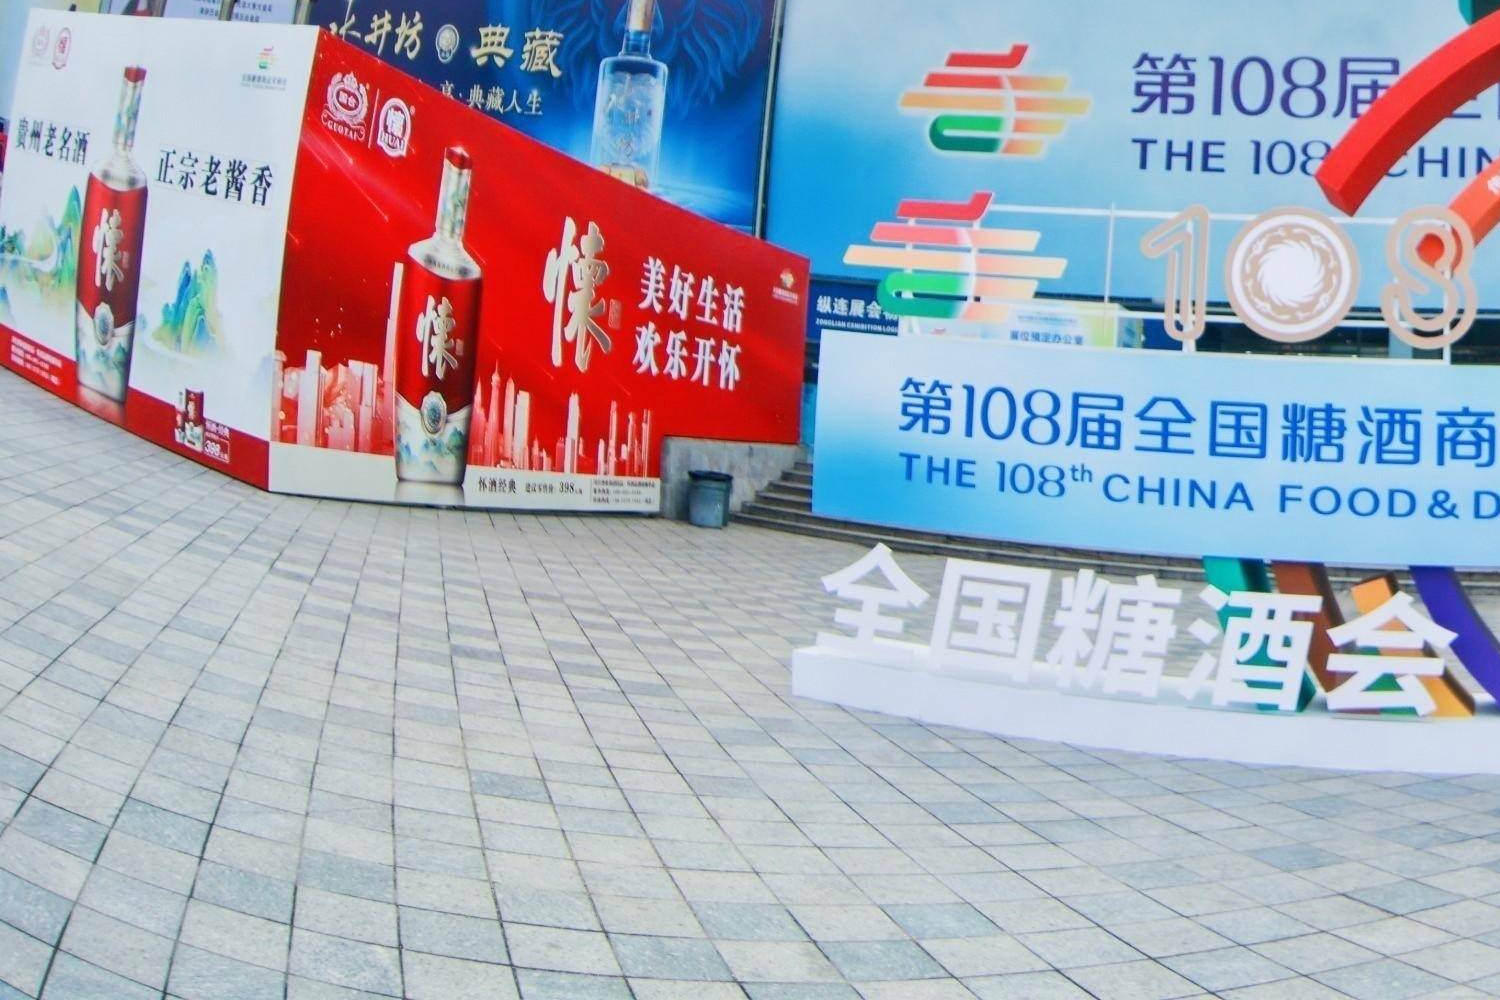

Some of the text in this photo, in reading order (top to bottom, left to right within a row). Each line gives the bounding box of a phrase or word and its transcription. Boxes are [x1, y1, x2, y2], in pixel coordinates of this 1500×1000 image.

[470, 23, 564, 78] 典藏
[155, 150, 274, 207] 正宗老酱香
[1131, 138, 1226, 176] THE
[637, 255, 746, 333] 美好生活
[631, 321, 742, 392] 欢乐开怀
[899, 452, 977, 489] THE
[996, 460, 1093, 498] 108th
[1102, 473, 1254, 512] CHINA
[816, 541, 1458, 718] 全国糖酒会
